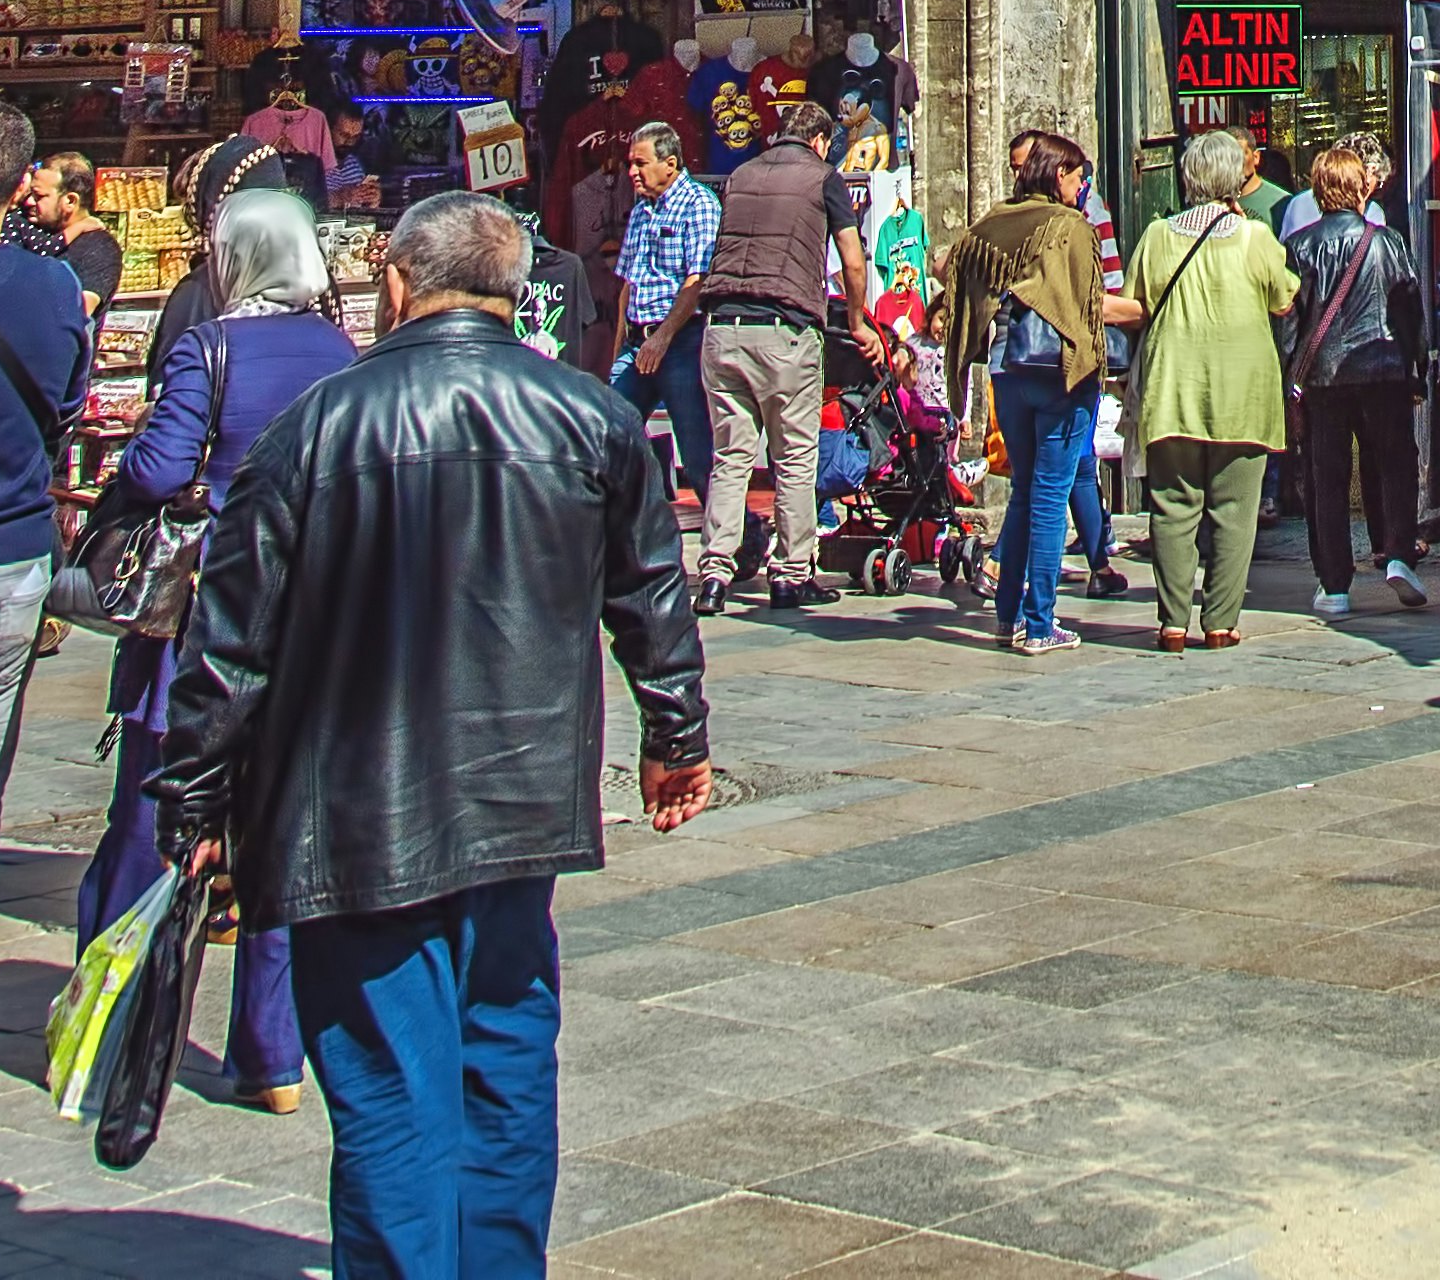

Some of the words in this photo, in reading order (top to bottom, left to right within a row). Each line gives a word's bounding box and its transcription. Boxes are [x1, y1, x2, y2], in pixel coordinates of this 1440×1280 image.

[1181, 12, 1289, 46] ALTIN
[589, 56, 602, 80] I
[1178, 52, 1298, 87] ALINIR
[479, 143, 512, 180] 10
